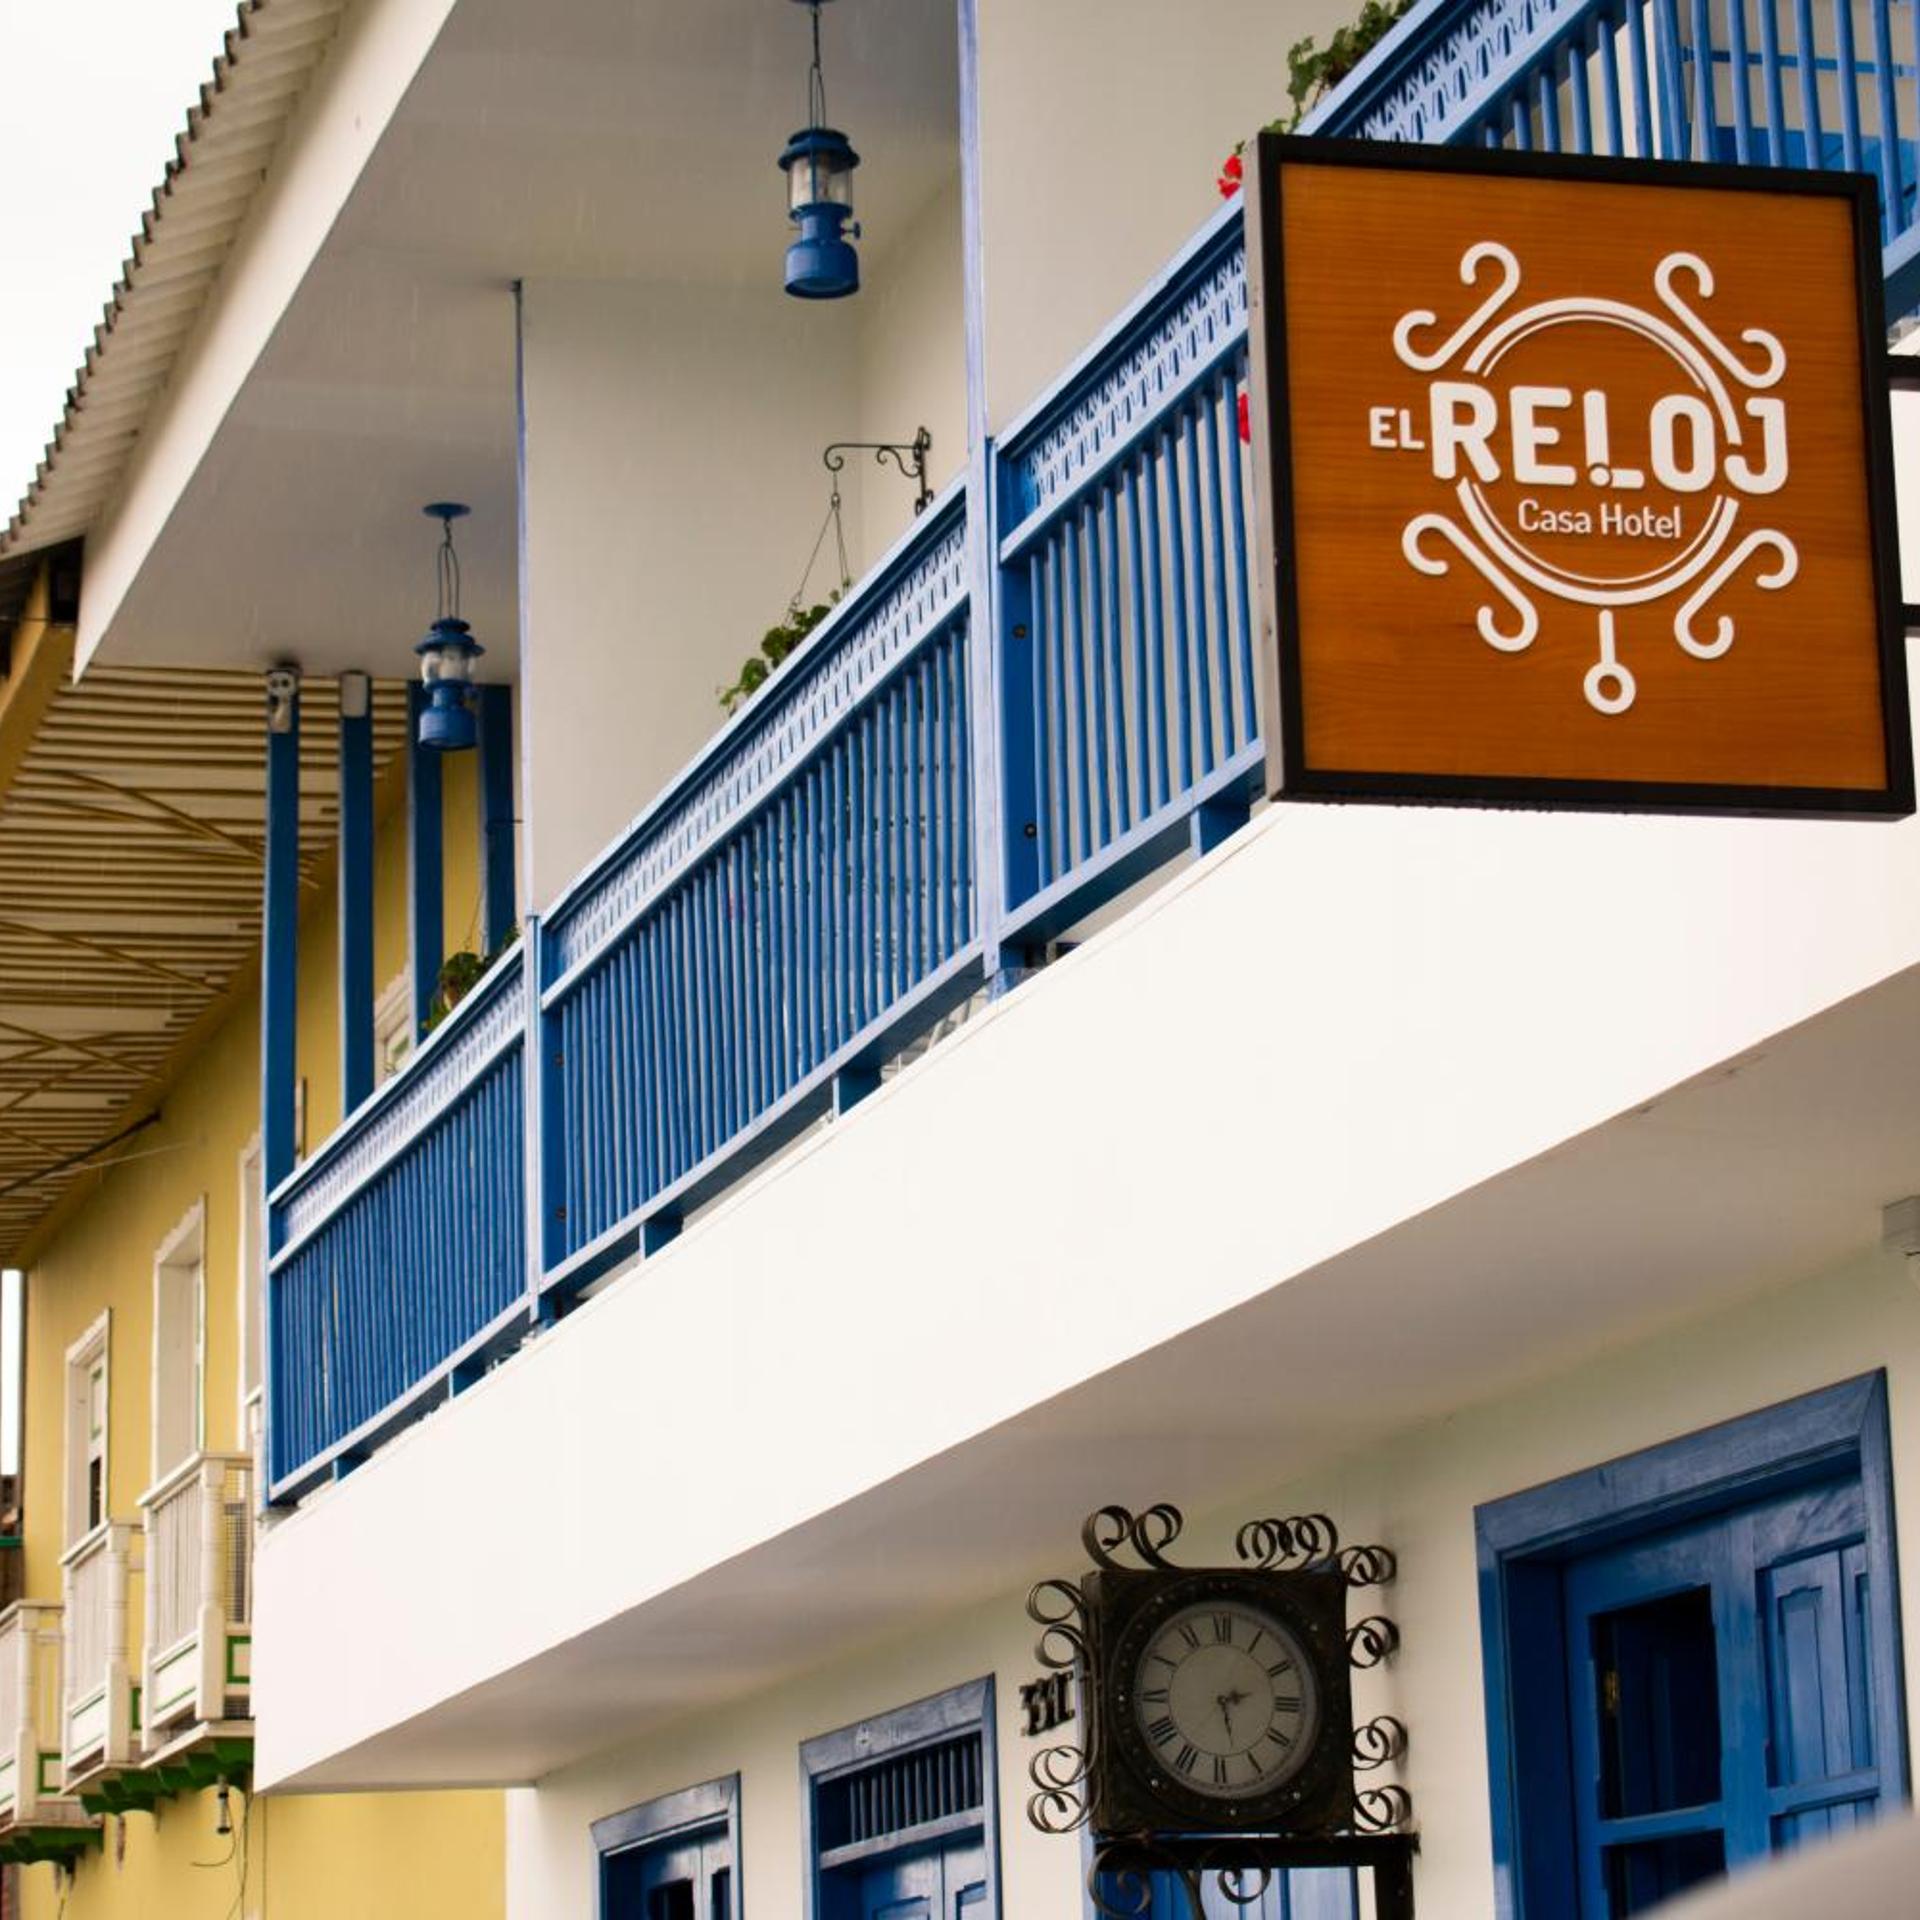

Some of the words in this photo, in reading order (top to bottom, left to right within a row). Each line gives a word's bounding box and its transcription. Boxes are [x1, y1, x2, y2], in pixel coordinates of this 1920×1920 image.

[1370, 407, 1424, 449] EL
[1430, 381, 1788, 494] RELOJ
[1518, 500, 1592, 534] Casa
[1600, 503, 1682, 539] Hotel
